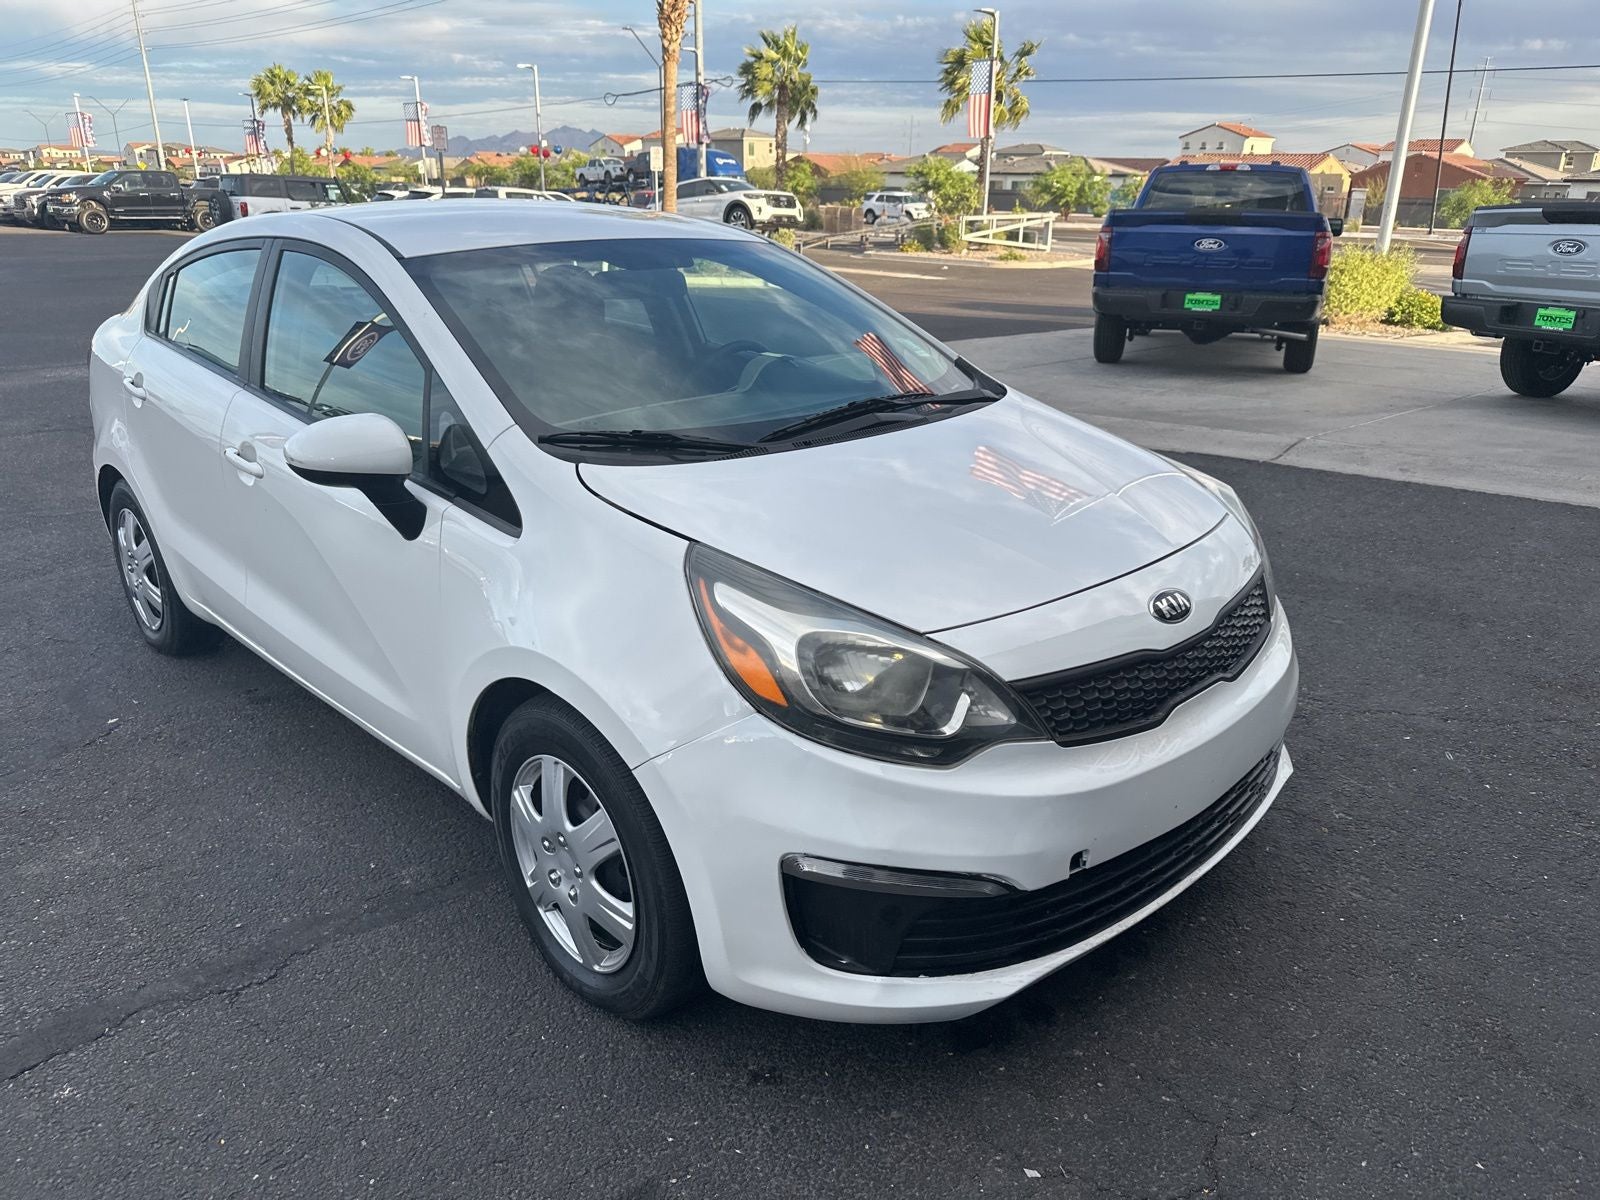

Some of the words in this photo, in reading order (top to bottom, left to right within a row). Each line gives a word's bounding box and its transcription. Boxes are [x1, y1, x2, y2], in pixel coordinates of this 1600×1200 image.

[1198, 239, 1221, 250] Ford
[1555, 240, 1580, 254] Ford
[1497, 259, 1600, 277] F-15
[1187, 298, 1219, 306] JONES
[1537, 314, 1573, 324] JONES
[1154, 592, 1190, 619] KIA
